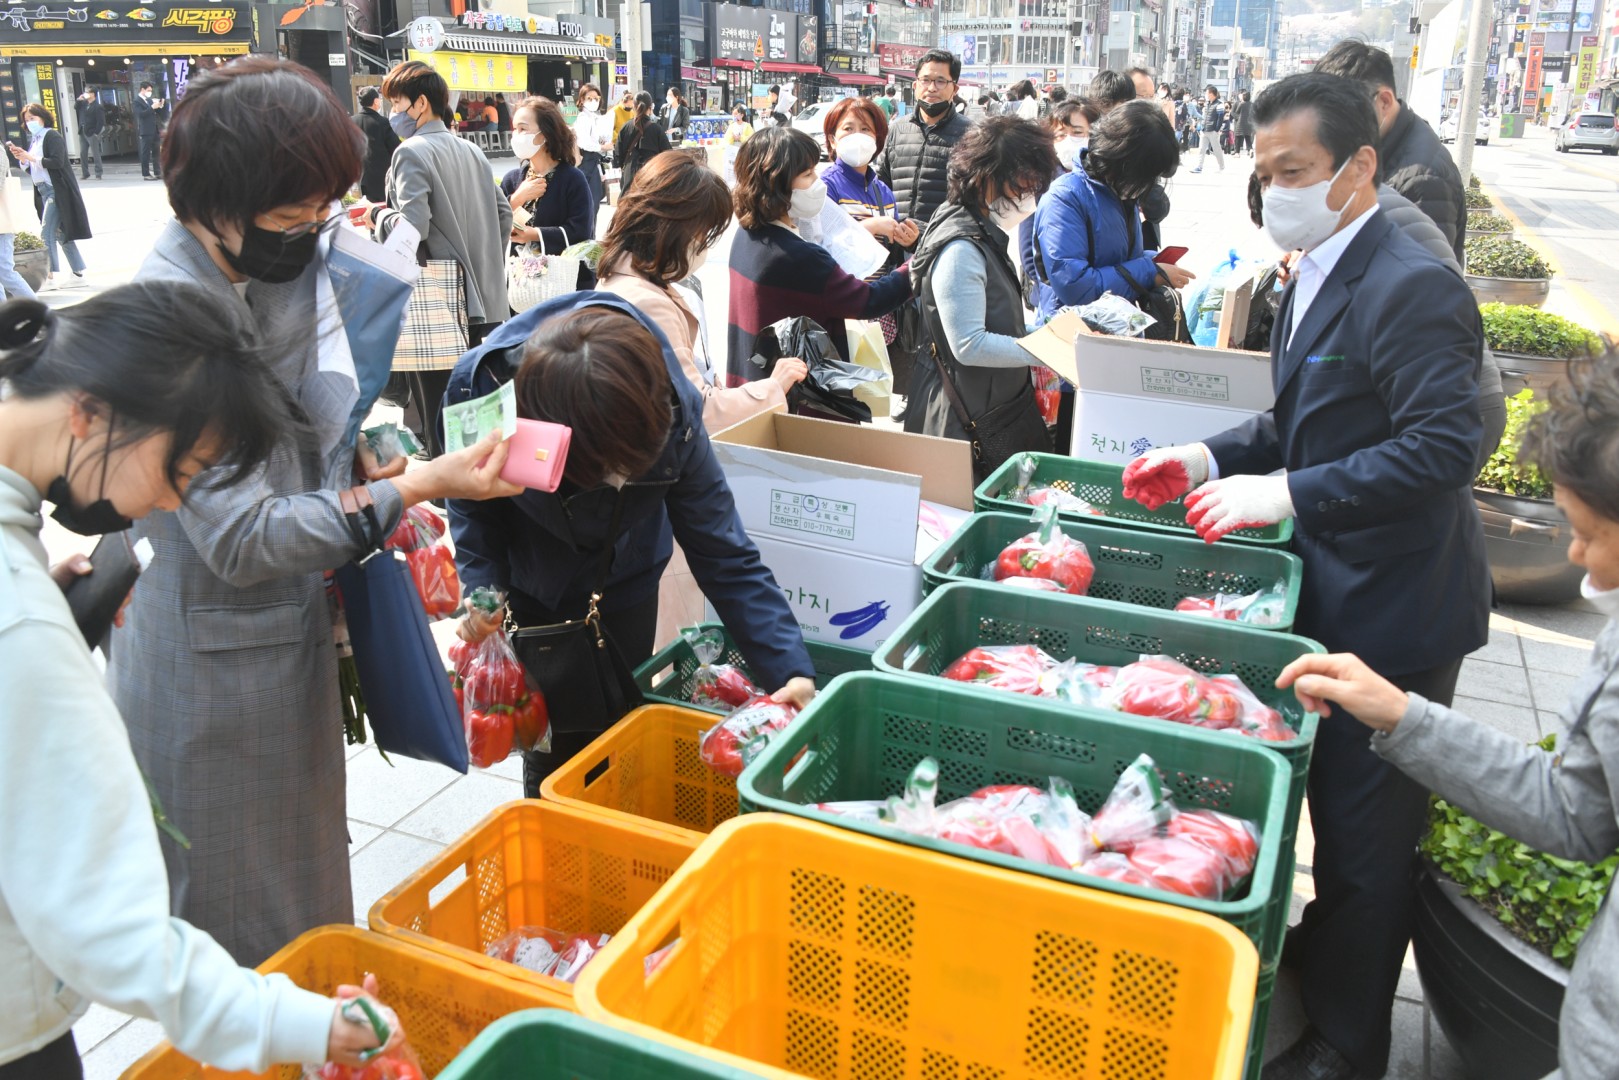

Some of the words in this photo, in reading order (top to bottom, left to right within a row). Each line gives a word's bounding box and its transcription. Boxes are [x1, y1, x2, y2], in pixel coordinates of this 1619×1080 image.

[416, 23, 433, 34] 사주
[467, 11, 485, 29] 사주
[486, 14, 504, 30] 궁합
[506, 16, 522, 31] 타로
[560, 22, 583, 36] FOOD
[418, 36, 434, 47] 궁합
[1579, 53, 1593, 90] 돼지갈비
[774, 516, 799, 527] 전화번호
[803, 521, 852, 537] 010-7179-6878
[784, 587, 829, 613] 가지
